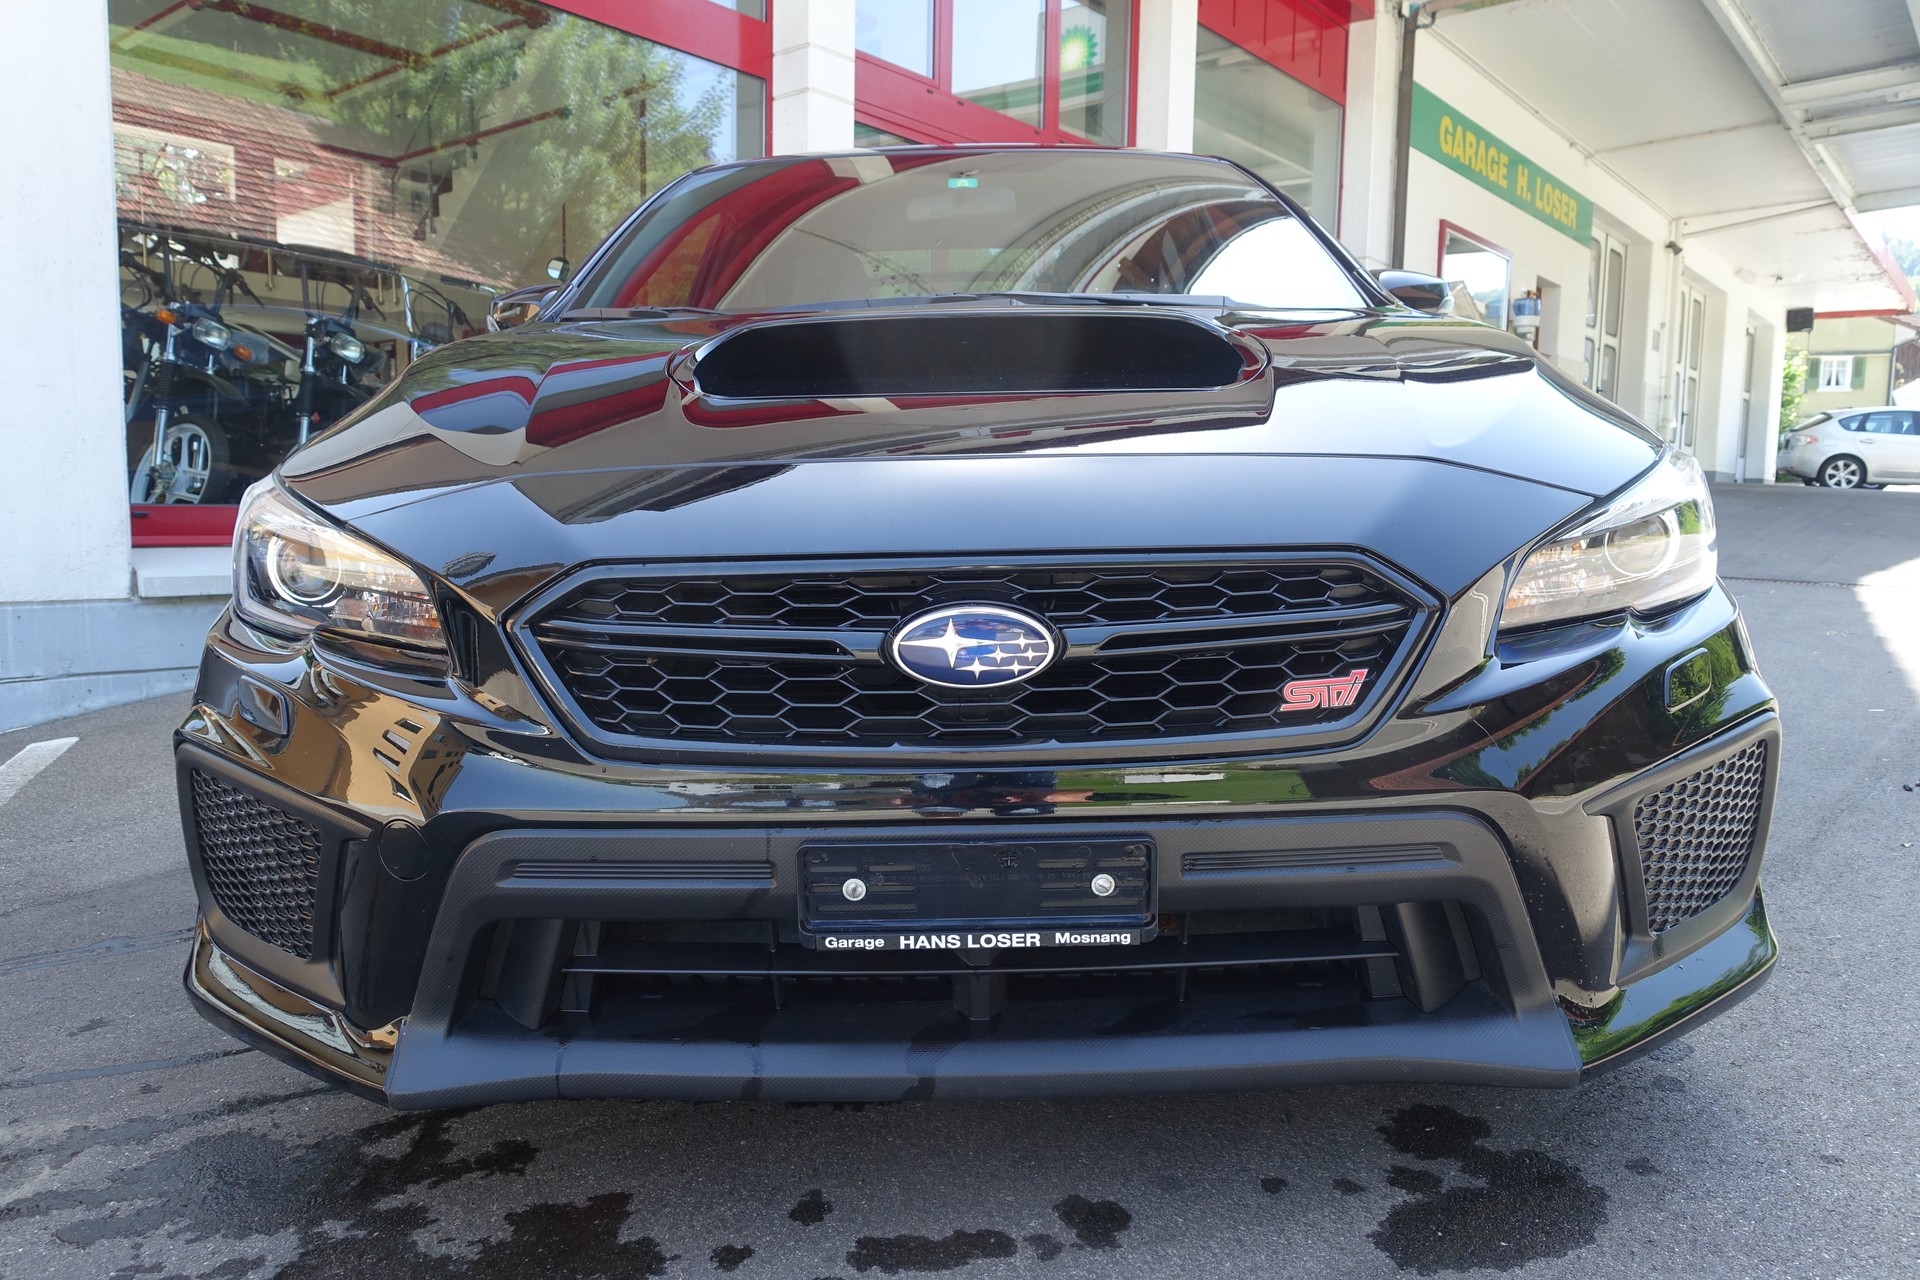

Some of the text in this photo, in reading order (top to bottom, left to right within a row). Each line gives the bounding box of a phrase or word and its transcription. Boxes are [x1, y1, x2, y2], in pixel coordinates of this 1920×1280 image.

[1439, 115, 1578, 230] GARAGE H. LOSER
[824, 931, 1131, 950] Garage HANS LOSER Mosnang
